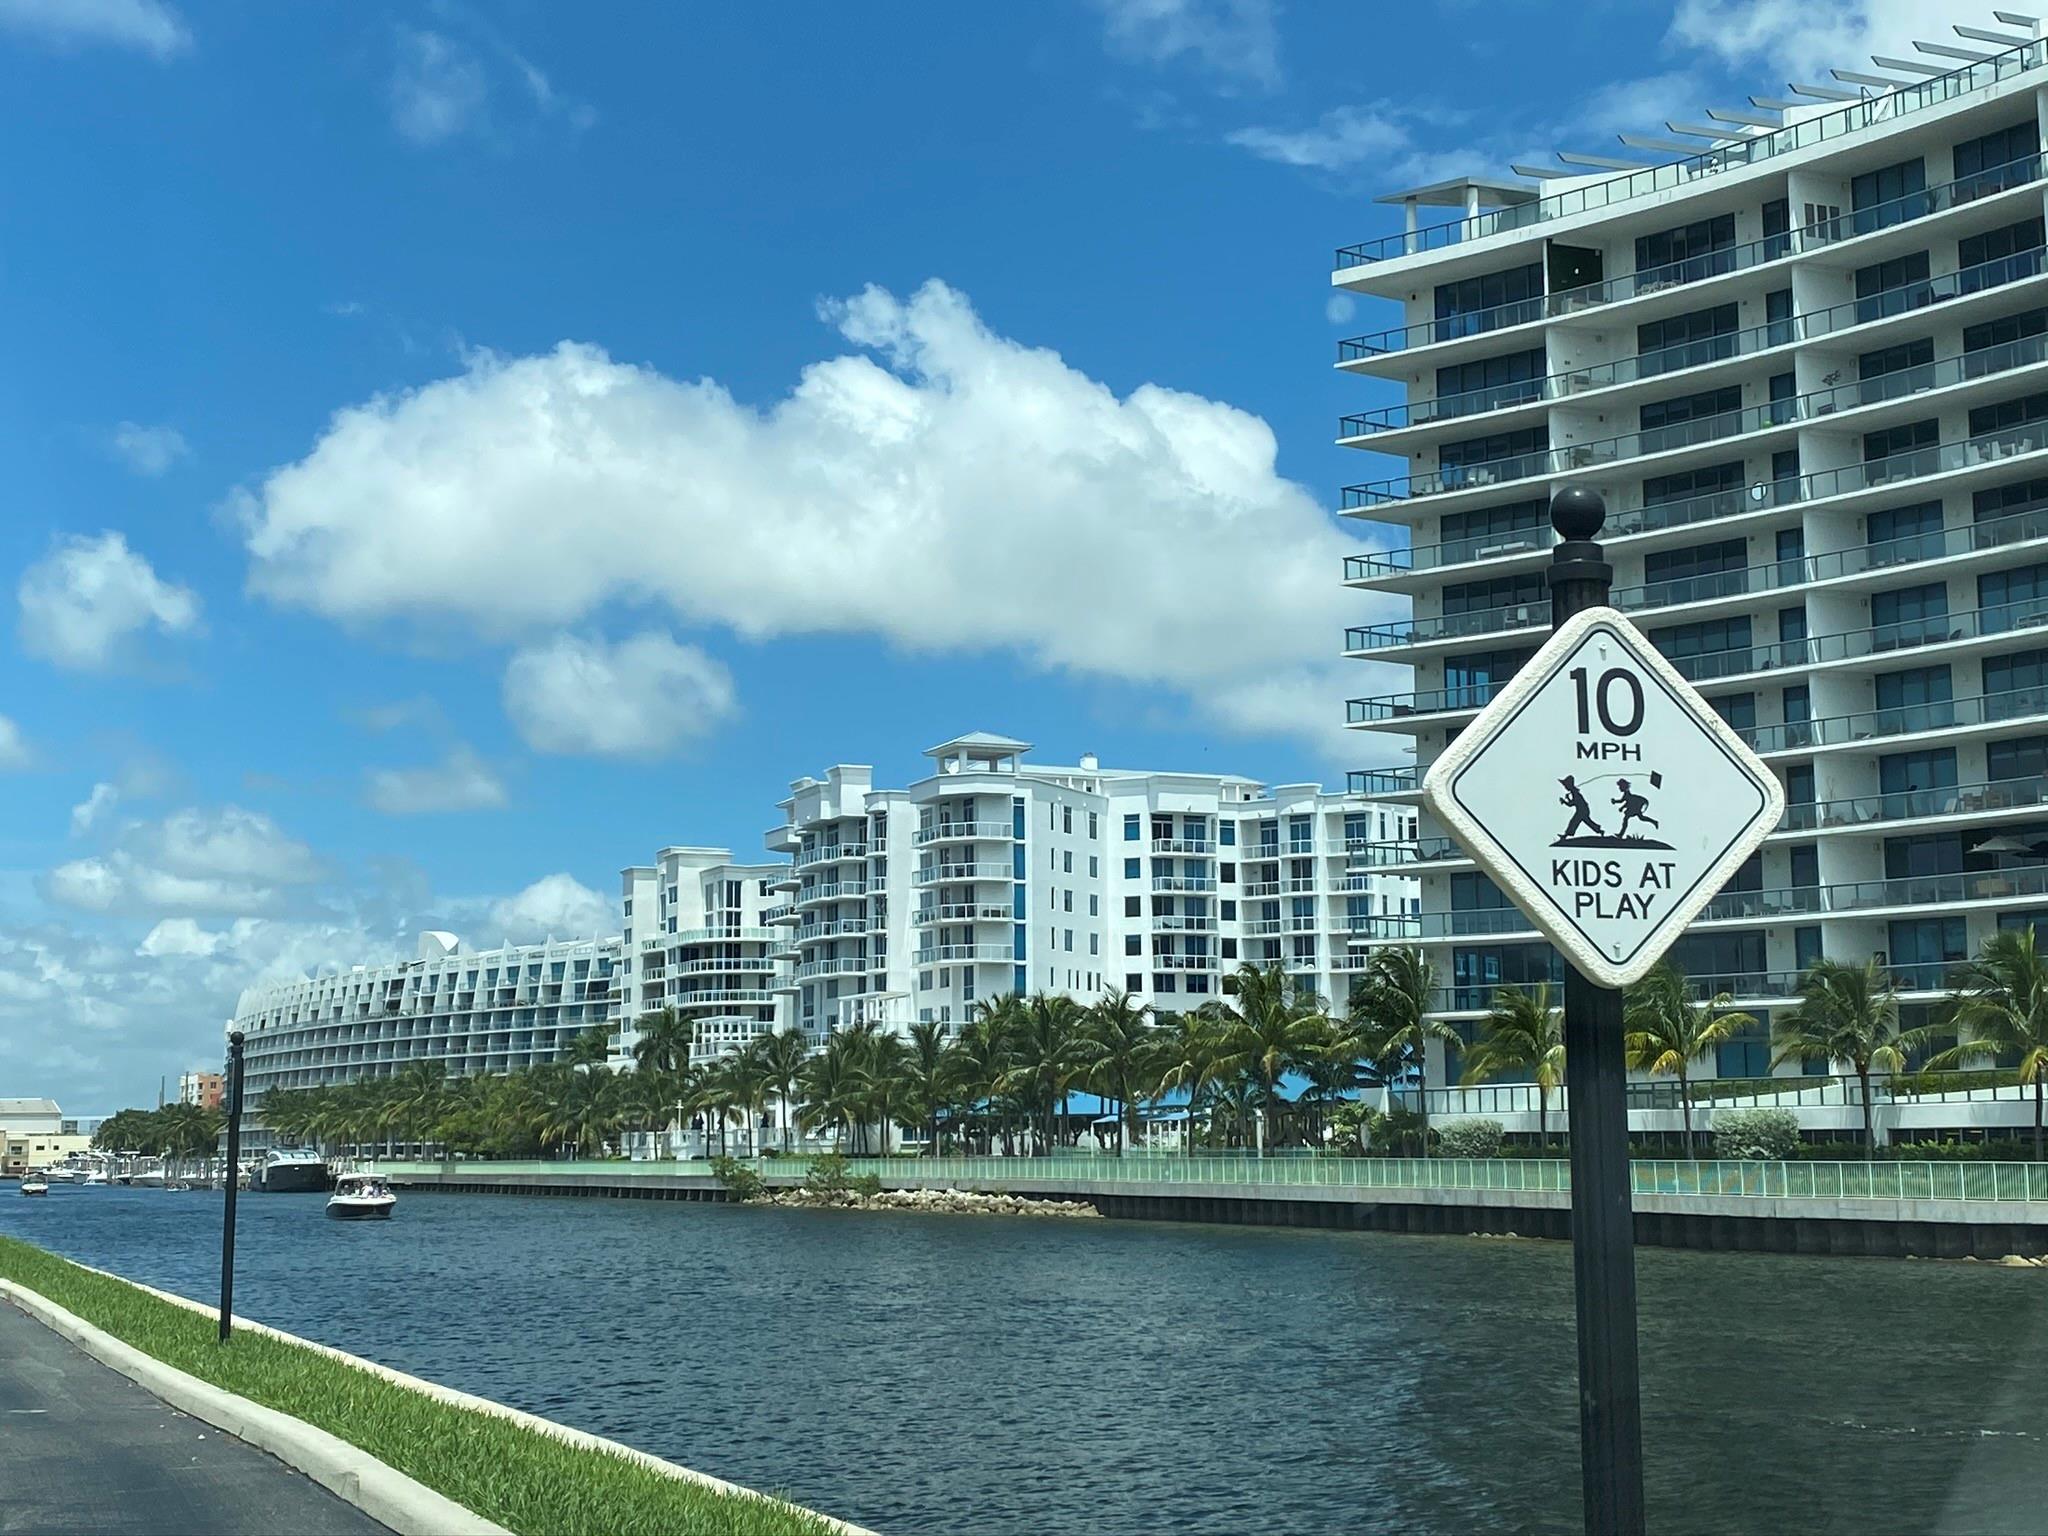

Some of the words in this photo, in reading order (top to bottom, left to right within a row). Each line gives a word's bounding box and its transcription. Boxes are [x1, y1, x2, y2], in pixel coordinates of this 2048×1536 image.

[1569, 667, 1645, 737] 10
[1576, 741, 1642, 762] MPH
[1552, 859, 1623, 888] KIDS
[1639, 862, 1676, 889] AT
[1575, 891, 1655, 920] PLAY
